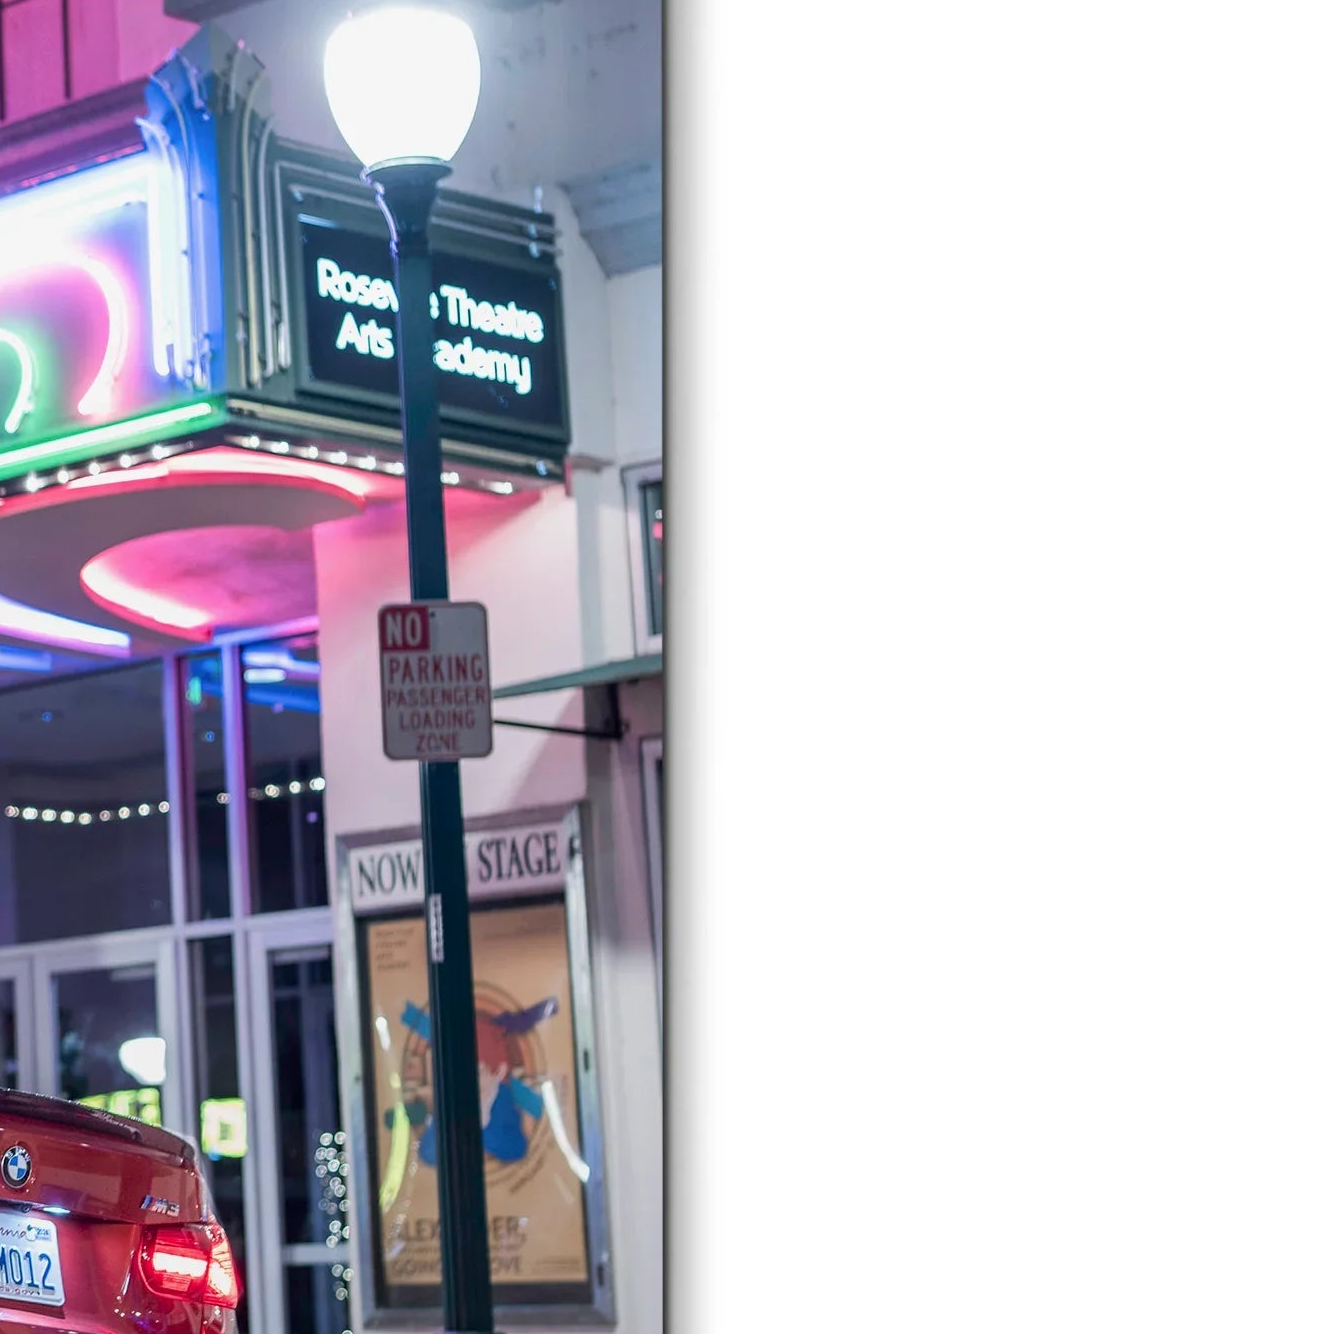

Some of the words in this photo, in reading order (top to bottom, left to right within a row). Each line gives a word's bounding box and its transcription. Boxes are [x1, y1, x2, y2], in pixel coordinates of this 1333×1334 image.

[439, 283, 545, 344] Theatre
[335, 311, 395, 360] Arts
[386, 611, 422, 646] NO
[388, 654, 483, 684] PARKING
[386, 686, 486, 708] PASSENGER
[399, 709, 475, 731] LOADING
[416, 733, 459, 753] ZONE
[359, 849, 422, 897] NOW
[478, 830, 561, 883] STAGE
